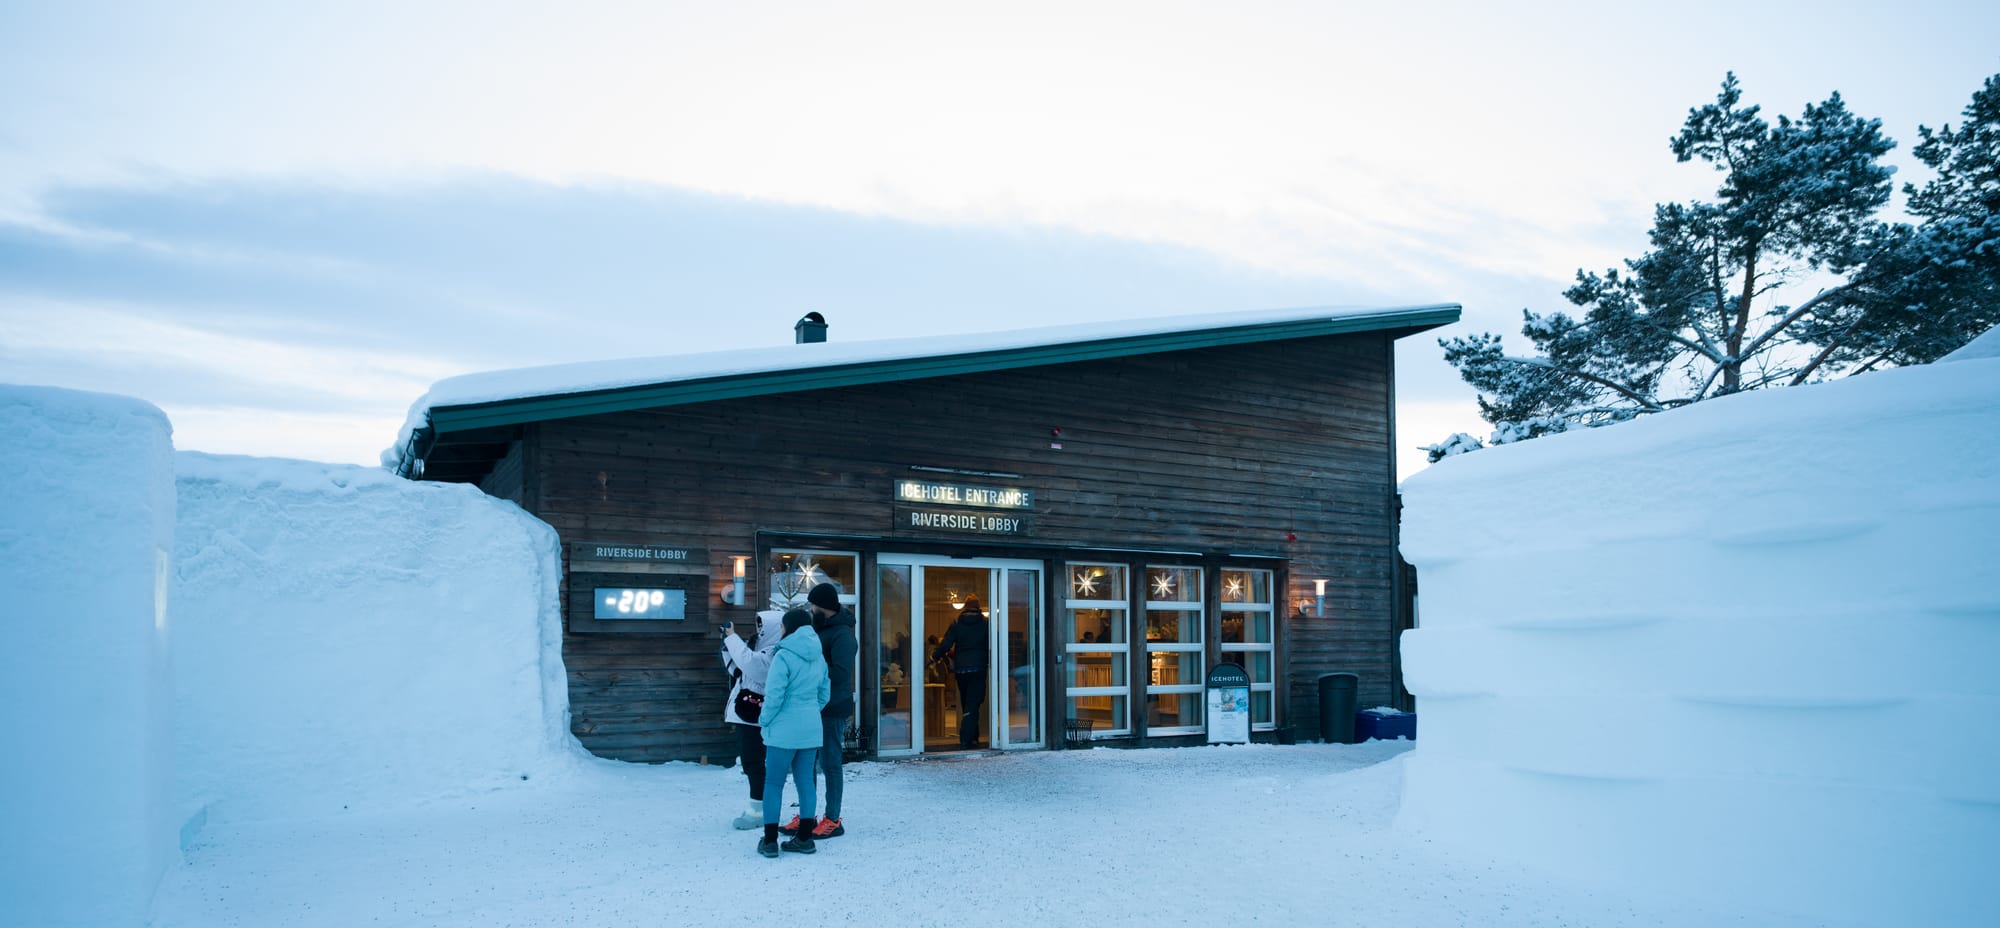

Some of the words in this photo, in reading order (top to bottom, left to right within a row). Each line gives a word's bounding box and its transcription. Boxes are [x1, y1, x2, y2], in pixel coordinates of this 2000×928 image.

[900, 483, 962, 502] ICEHOTEL
[965, 488, 1029, 506] ENTRANCE
[911, 512, 977, 529] RIVERSIDE
[981, 517, 1020, 532] LOBBY
[596, 547, 652, 558] RIVERSIDE
[654, 549, 688, 560] LOBBY
